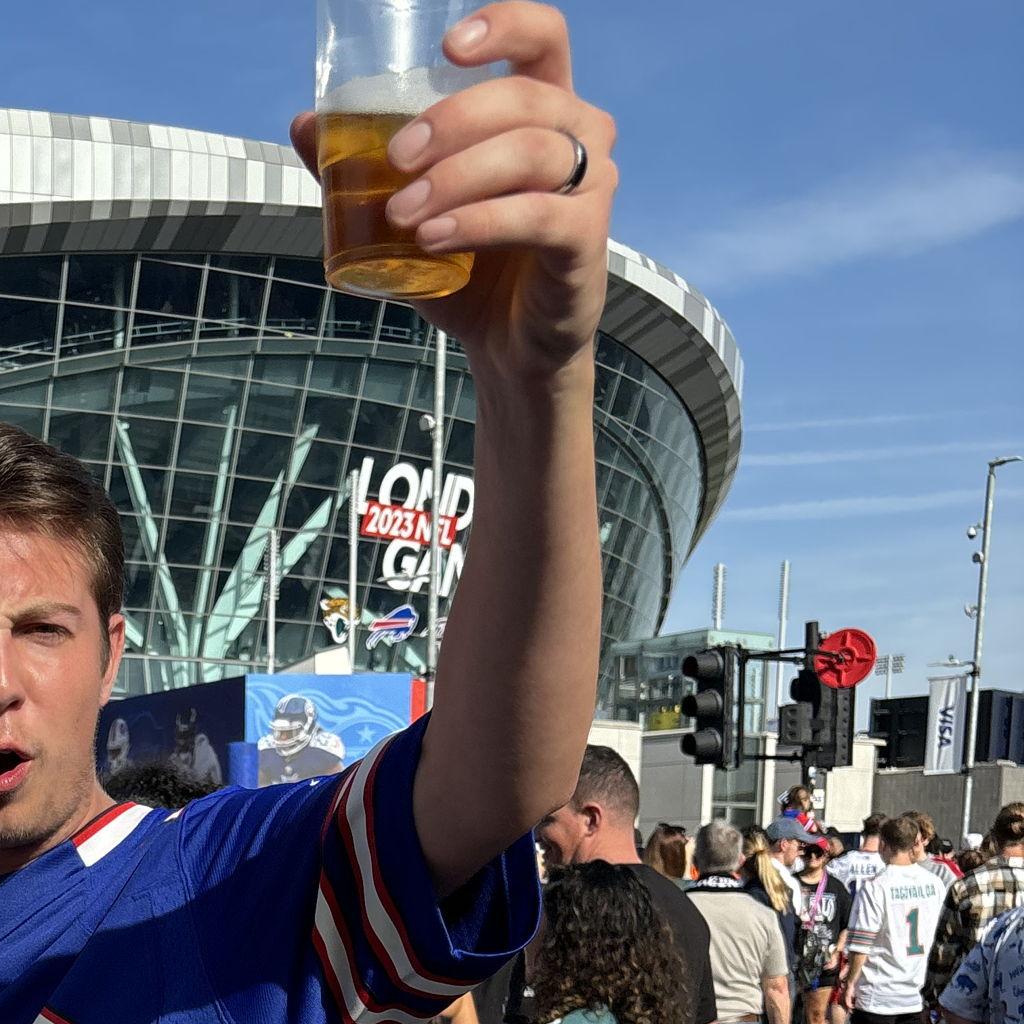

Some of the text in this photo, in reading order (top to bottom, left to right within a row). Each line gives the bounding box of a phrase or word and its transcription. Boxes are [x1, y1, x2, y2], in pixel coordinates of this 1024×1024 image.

[365, 506, 414, 539] 2023
[938, 706, 954, 749] VISA
[849, 863, 876, 875] ALLEN
[906, 908, 924, 956] 1
